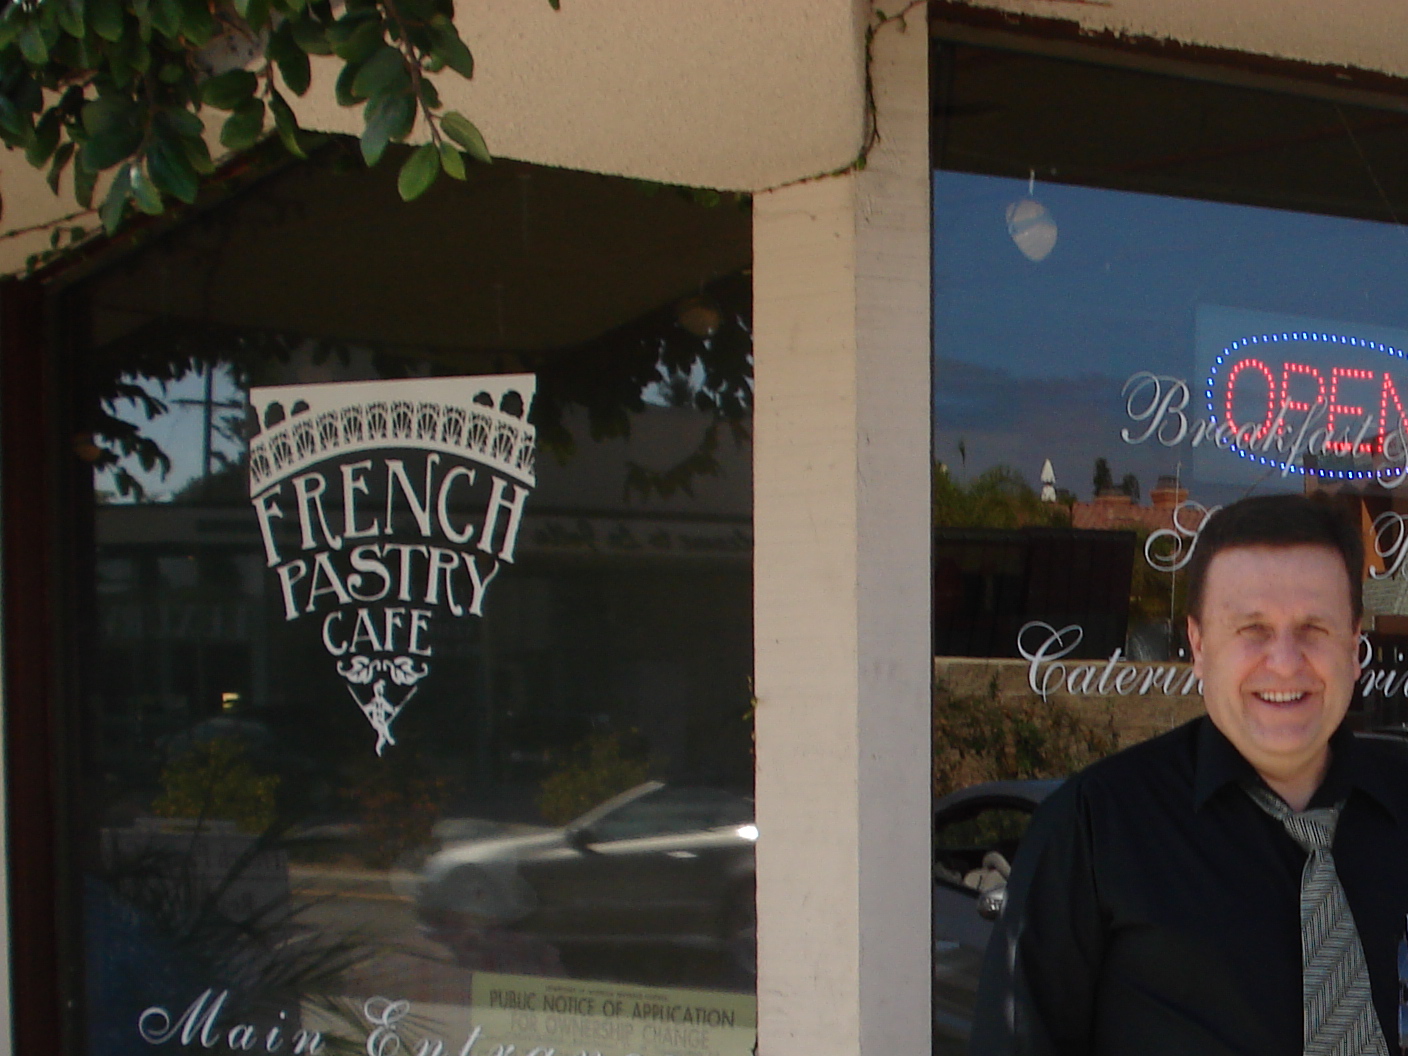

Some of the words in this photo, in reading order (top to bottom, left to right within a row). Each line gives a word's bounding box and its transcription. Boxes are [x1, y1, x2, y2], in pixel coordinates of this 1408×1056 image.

[1121, 371, 1374, 480] Breakfast
[252, 453, 530, 567] FRENCH
[277, 542, 502, 620] PASTRY
[322, 606, 433, 657] CAFE
[1018, 620, 1204, 702] Caterin
[138, 987, 326, 1056] Main
[489, 988, 536, 1011] PUBLIC
[542, 995, 595, 1017] NOTICE
[602, 1000, 624, 1018] OF
[631, 1002, 736, 1028] APPLICATION
[510, 1014, 538, 1032] FOR
[545, 1016, 634, 1039] OWNERSHIP
[642, 1024, 710, 1049] CHANGE
